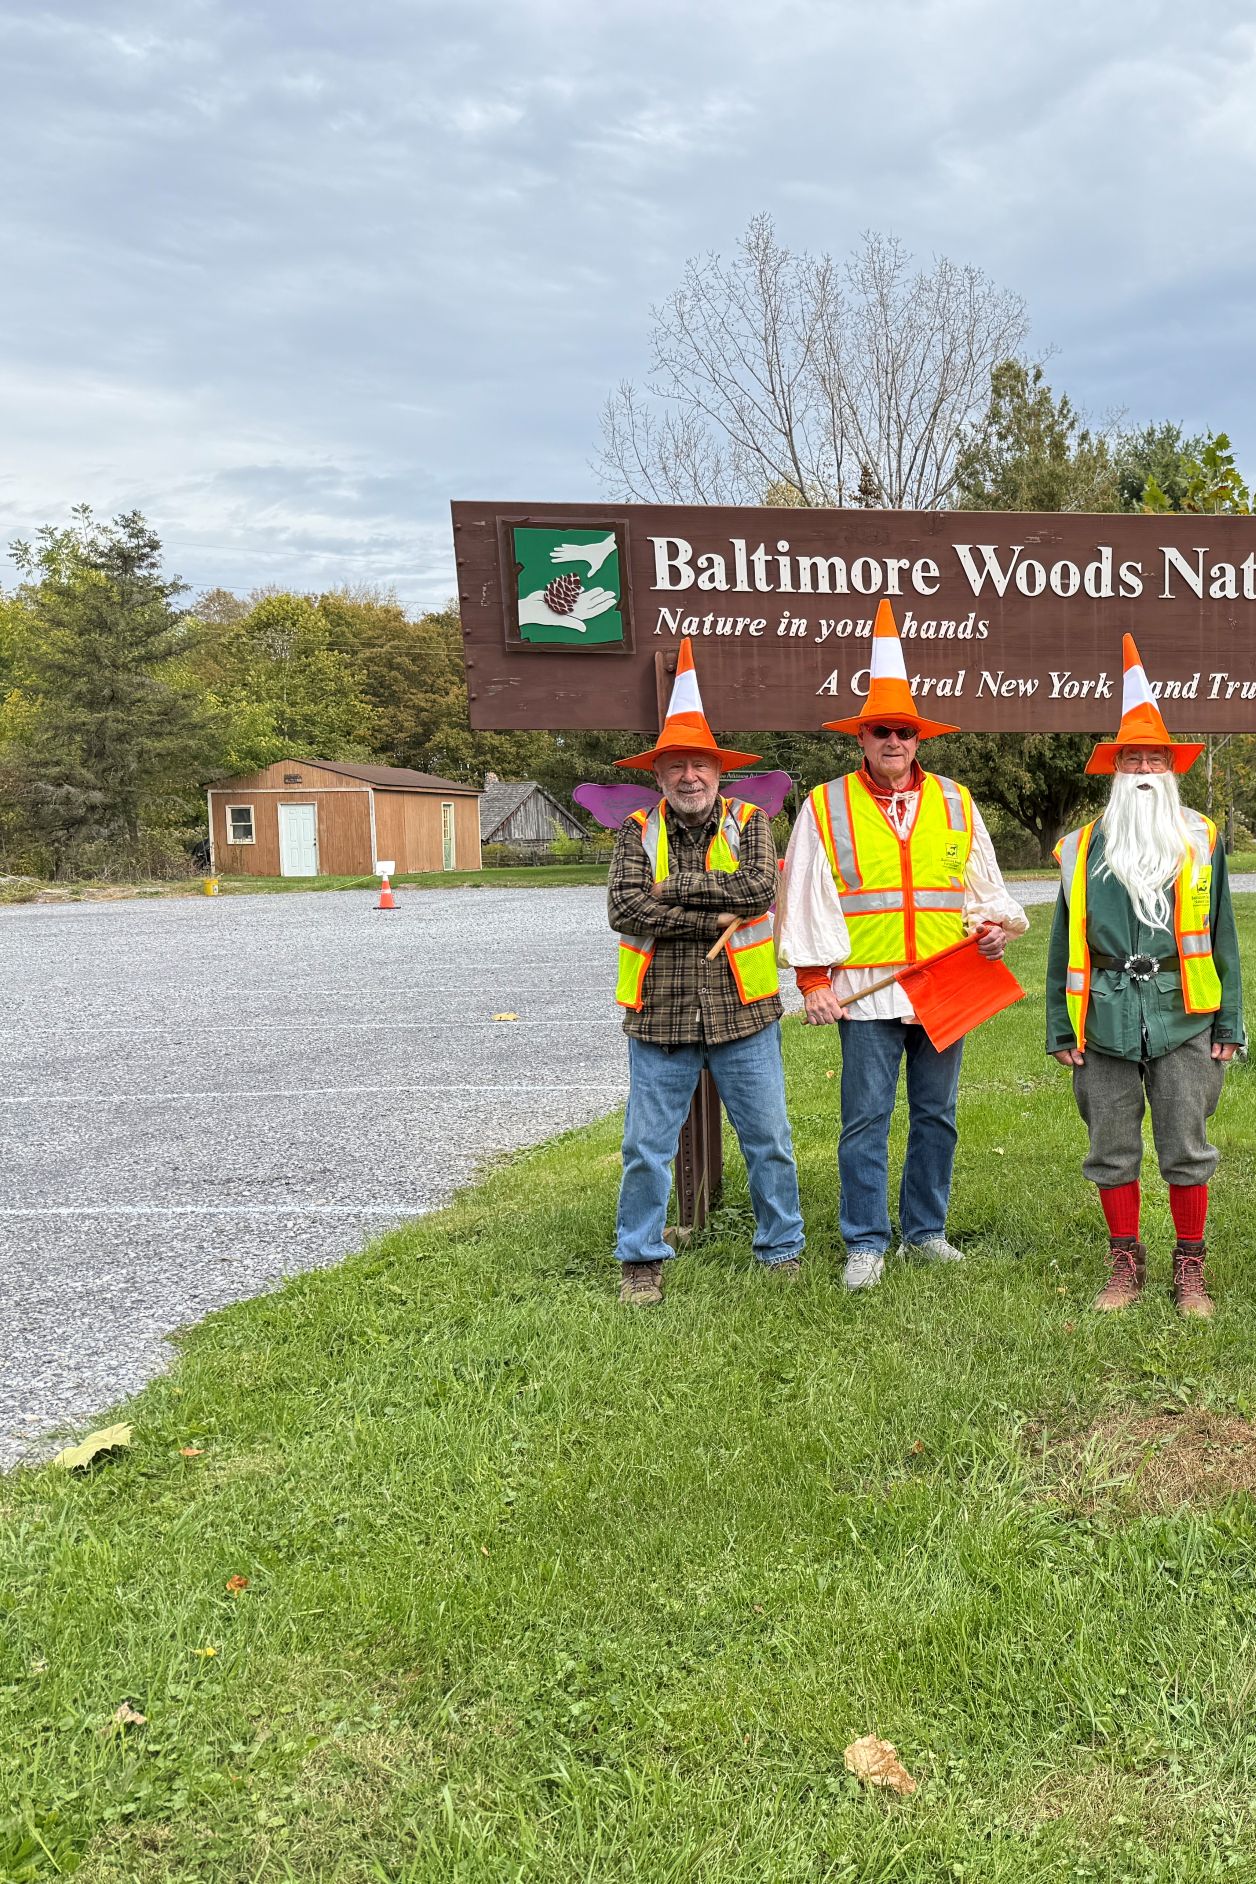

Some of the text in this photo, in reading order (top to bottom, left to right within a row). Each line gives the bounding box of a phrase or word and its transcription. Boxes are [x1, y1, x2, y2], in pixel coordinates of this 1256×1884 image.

[646, 536, 940, 595] Baltimore
[951, 544, 1143, 598] Woods
[653, 607, 990, 643] Nature in you hands
[815, 669, 839, 696] A
[850, 668, 965, 697] Ctral
[974, 670, 1039, 698] New
[1048, 671, 1114, 699] York
[1149, 672, 1201, 699] and
